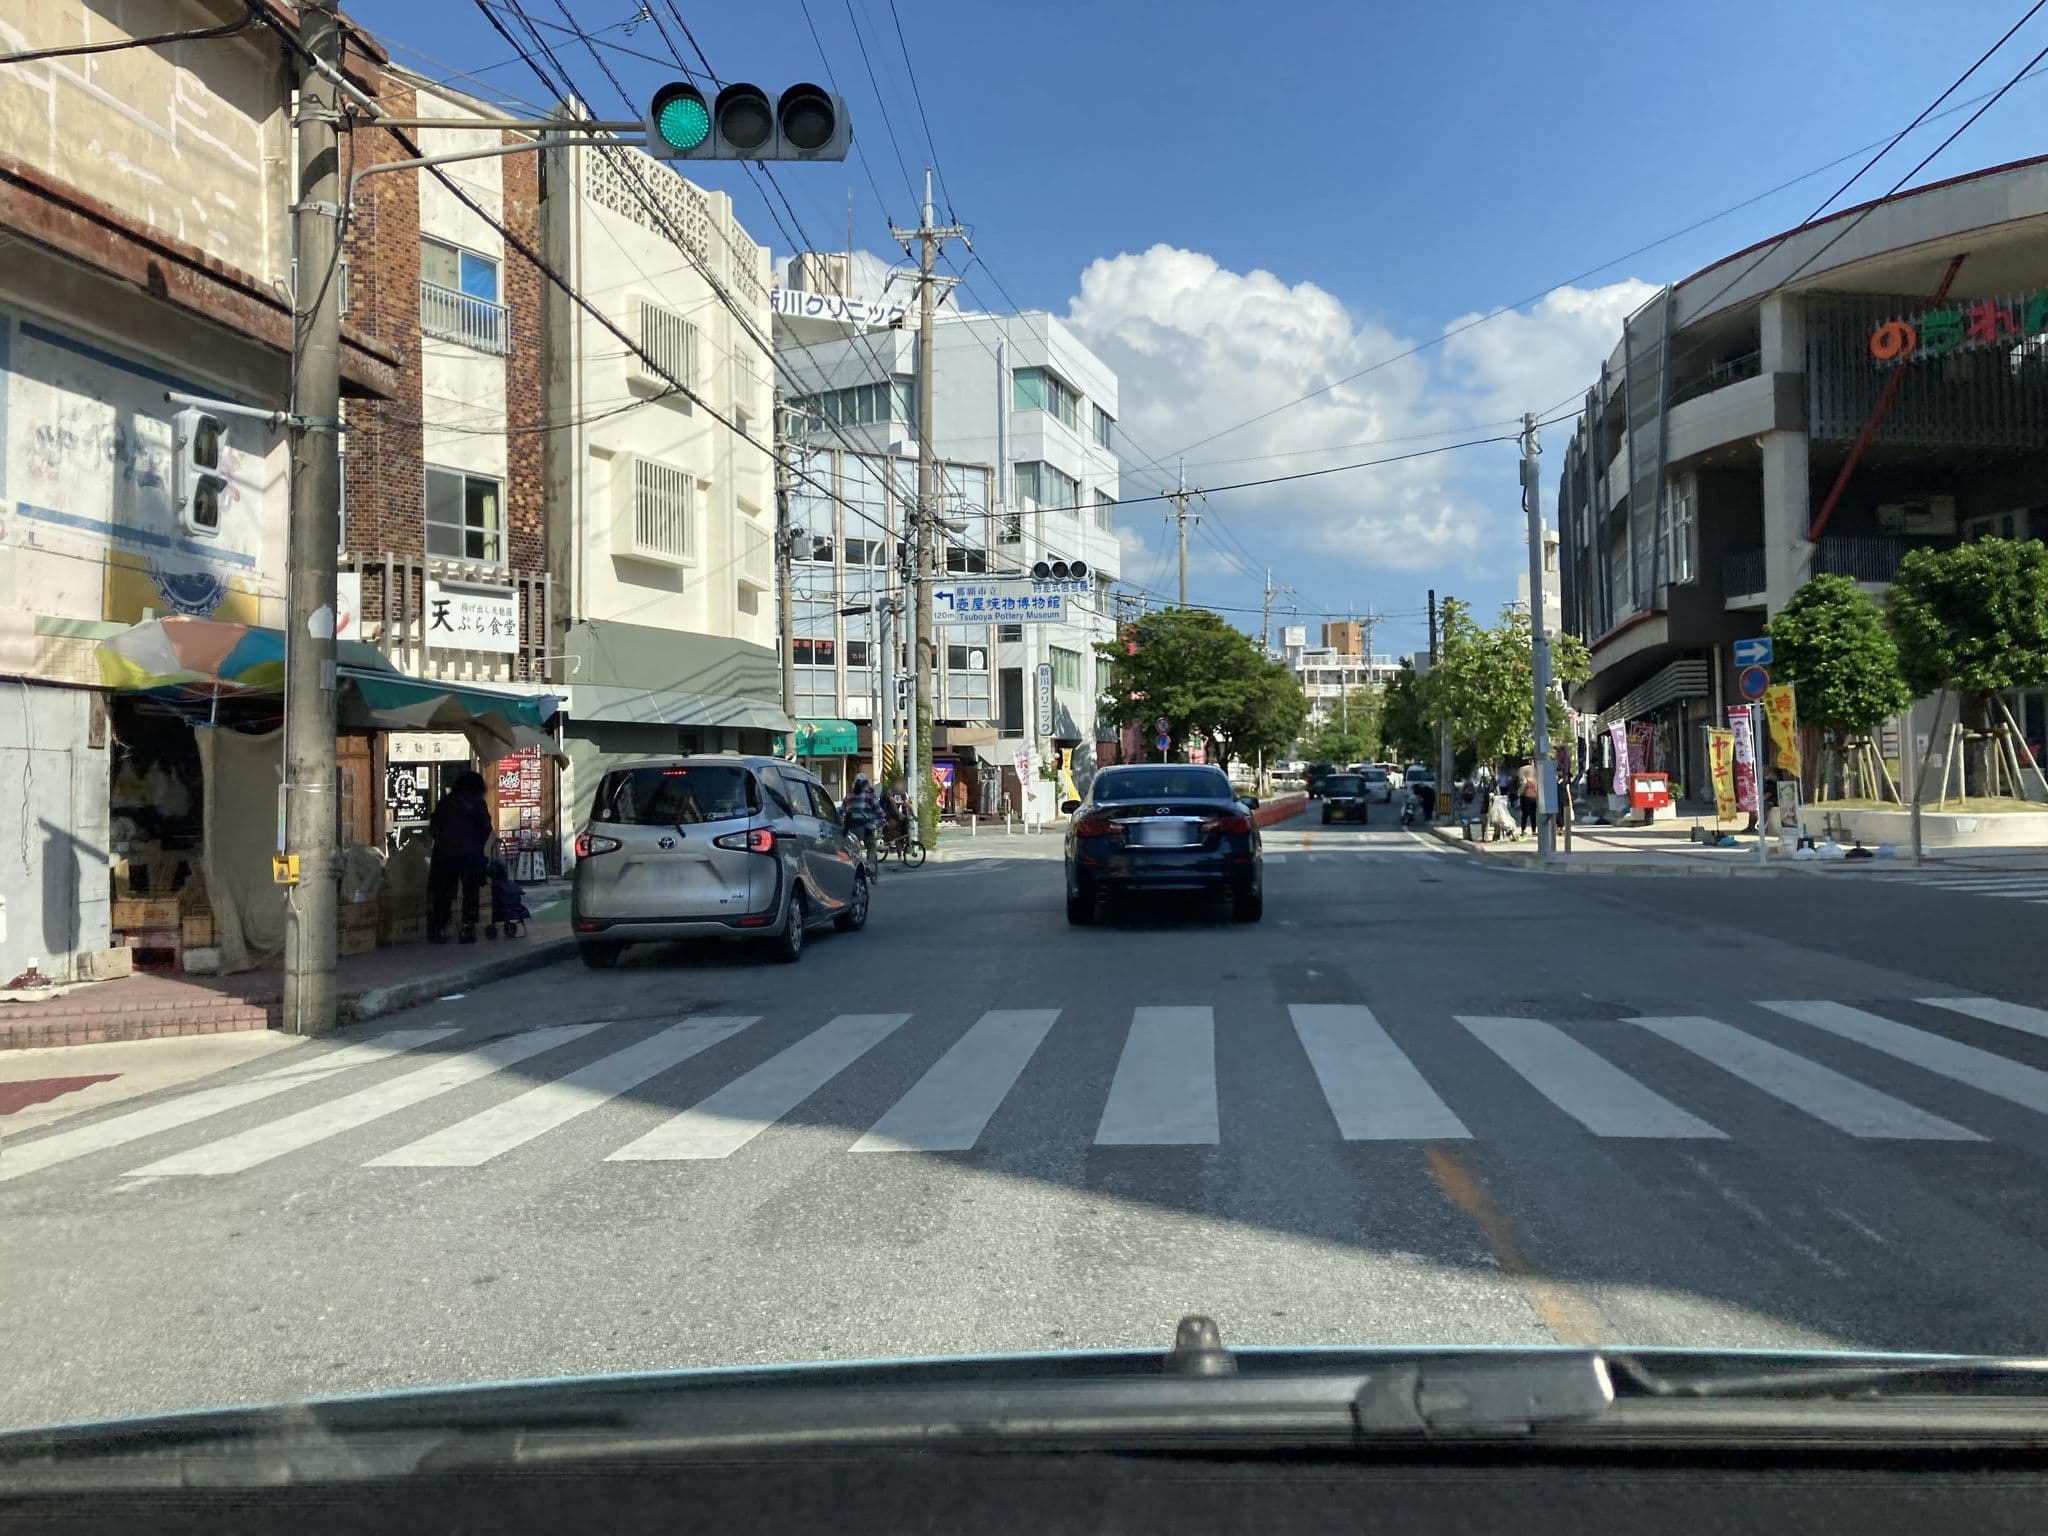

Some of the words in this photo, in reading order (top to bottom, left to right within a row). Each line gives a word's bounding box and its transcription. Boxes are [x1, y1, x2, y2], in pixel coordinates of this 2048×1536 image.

[959, 613, 992, 622] Tsuboya
[995, 612, 1023, 622] Pottery
[1026, 611, 1060, 619] Museum
[1040, 667, 1050, 732] 新川クリニック
